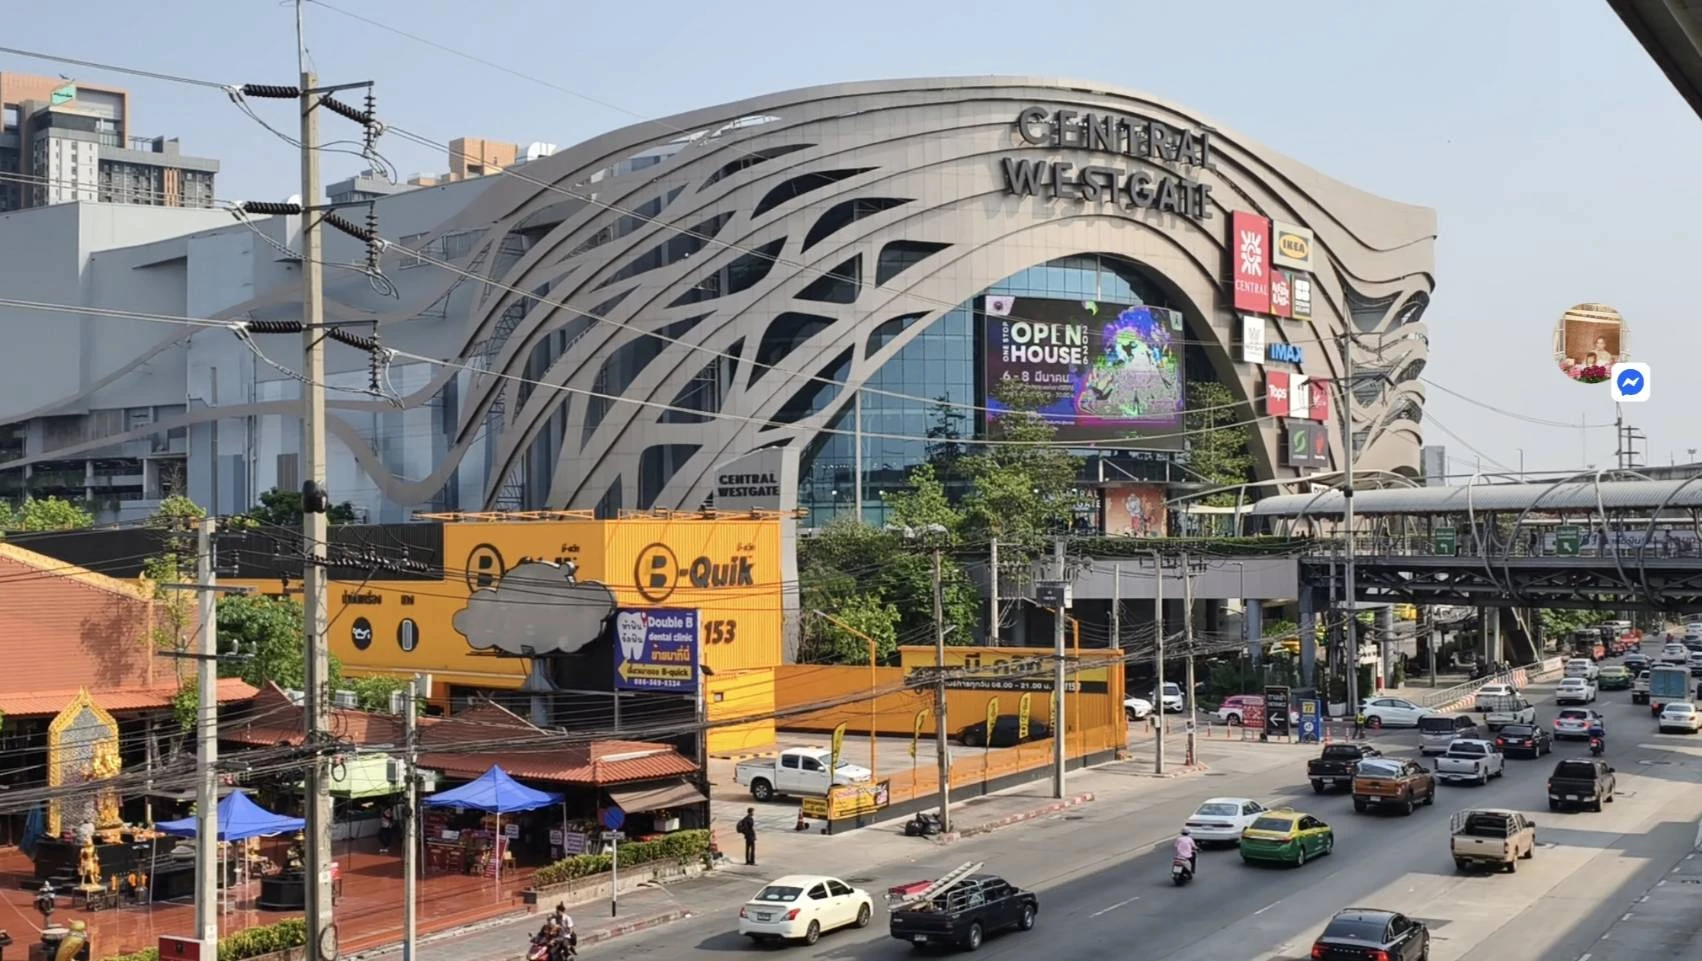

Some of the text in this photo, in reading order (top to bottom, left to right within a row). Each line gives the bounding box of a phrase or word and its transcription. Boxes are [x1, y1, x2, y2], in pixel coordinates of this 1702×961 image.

[1018, 106, 1216, 170] CENTRAL
[1002, 157, 1213, 220] WESTGATE
[1282, 239, 1305, 253] IKEA
[1235, 280, 1268, 296] CENTRAL
[1011, 322, 1081, 346] OPEN
[1011, 345, 1081, 365] HOUSE
[1270, 343, 1304, 364] IMAX
[1022, 371, 1030, 381] 8
[1268, 384, 1287, 402] Tops
[719, 473, 778, 484] CENTRAL
[718, 485, 780, 497] WESTGATE
[647, 616, 683, 628] Double
[648, 632, 693, 642] dental clinic
